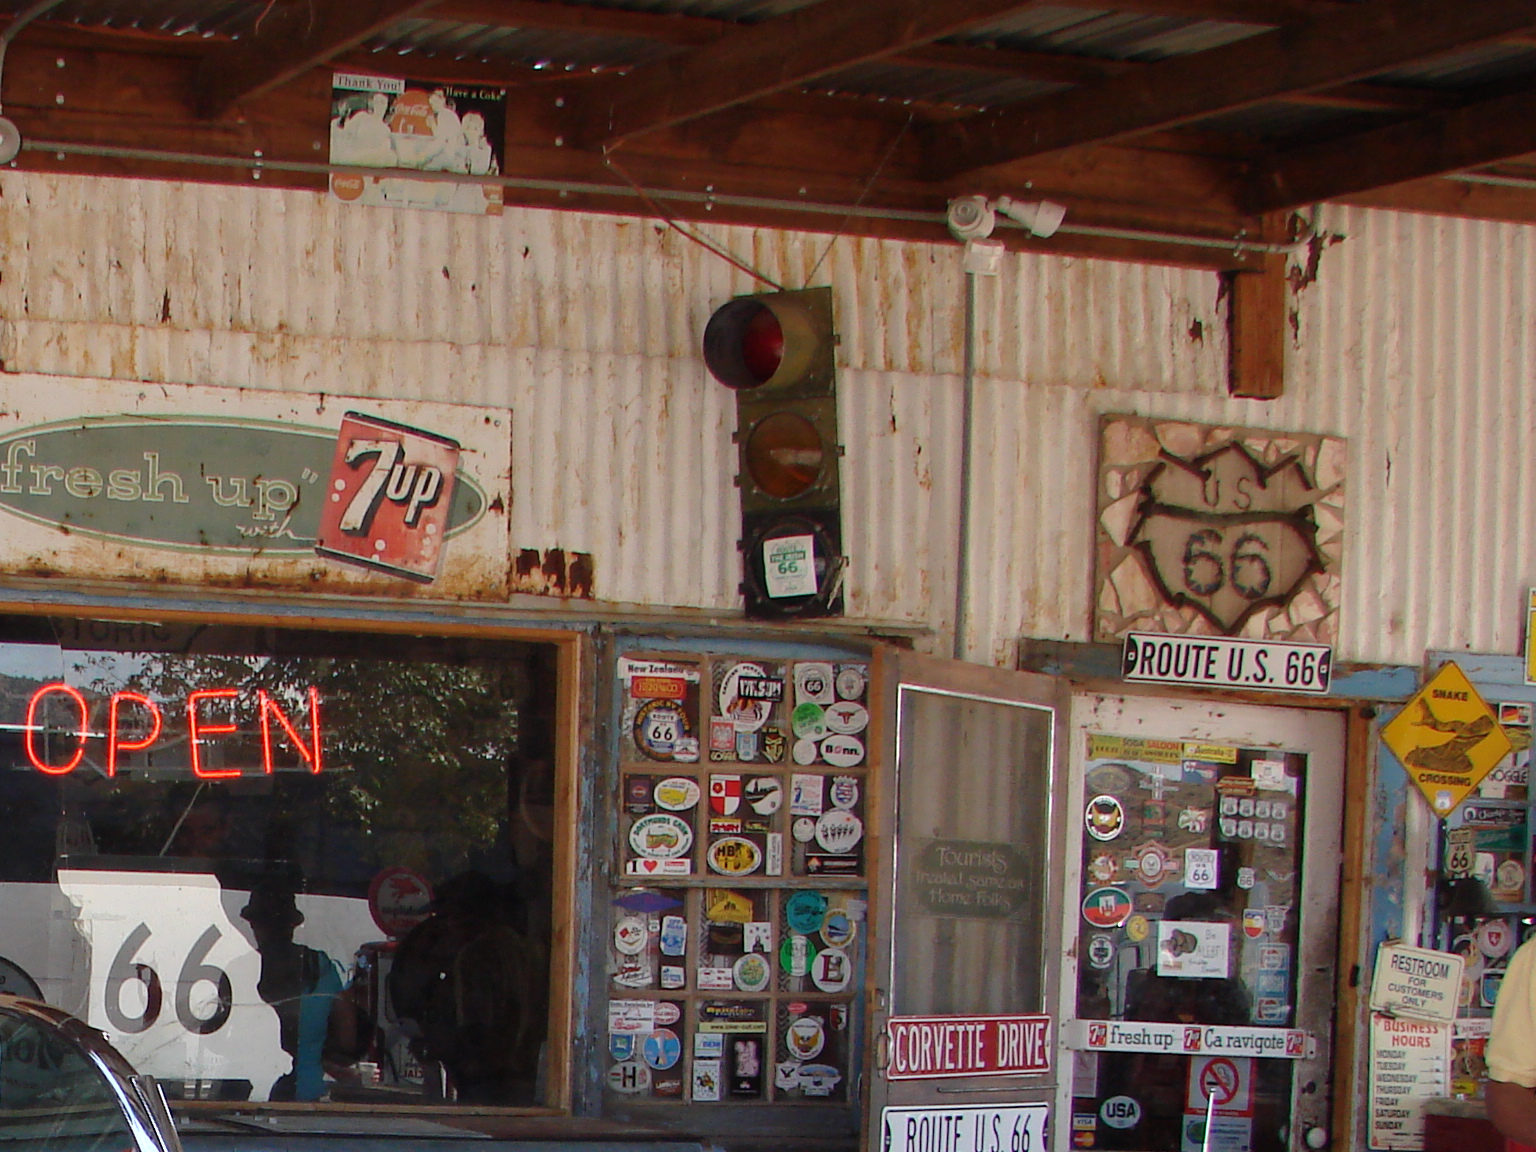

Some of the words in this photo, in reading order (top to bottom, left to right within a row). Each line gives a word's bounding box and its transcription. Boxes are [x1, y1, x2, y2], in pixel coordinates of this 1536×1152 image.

[337, 75, 373, 90] Thank
[377, 79, 402, 93] You!
[778, 561, 798, 575] 66
[1183, 527, 1272, 599] 66
[1138, 640, 1220, 680] ROUTE
[1226, 648, 1275, 684] U.S.
[1284, 653, 1315, 687] 66
[807, 681, 822, 692] 66
[1432, 689, 1468, 702] SNAKE
[652, 713, 674, 721] ROUTE
[24, 682, 323, 779] OPEN
[652, 726, 673, 741] 66
[1418, 773, 1471, 787] CROSSING
[935, 847, 1007, 874] Tourists
[1450, 852, 1469, 869] 66
[1192, 869, 1209, 881] 66
[1239, 876, 1253, 886] 66
[1390, 953, 1450, 979] RESTROOM
[104, 922, 233, 1036] 66
[1407, 976, 1427, 988] FOR
[1387, 982, 1444, 1001] CUSTOMERS
[1401, 995, 1427, 1008] ONLY
[1383, 1020, 1439, 1035] BUSINESS
[1109, 1024, 1151, 1045] fresh
[1226, 1033, 1284, 1054] ravigote
[1391, 1035, 1431, 1048] HOURS
[895, 1023, 986, 1073] CORVETTE
[996, 1022, 1045, 1068] DRIVE
[1376, 1050, 1406, 1059] MONDAY
[1376, 1062, 1406, 1071] TUESDAY
[622, 1066, 636, 1088] H
[1375, 1074, 1418, 1083] WEDNESDAY
[1375, 1085, 1412, 1095] THURSDAY
[1375, 1097, 1399, 1106] FRIDAY
[1106, 1103, 1136, 1118] USA
[1375, 1109, 1411, 1119] SATURDAY
[1375, 1121, 1403, 1130] SUNDAY
